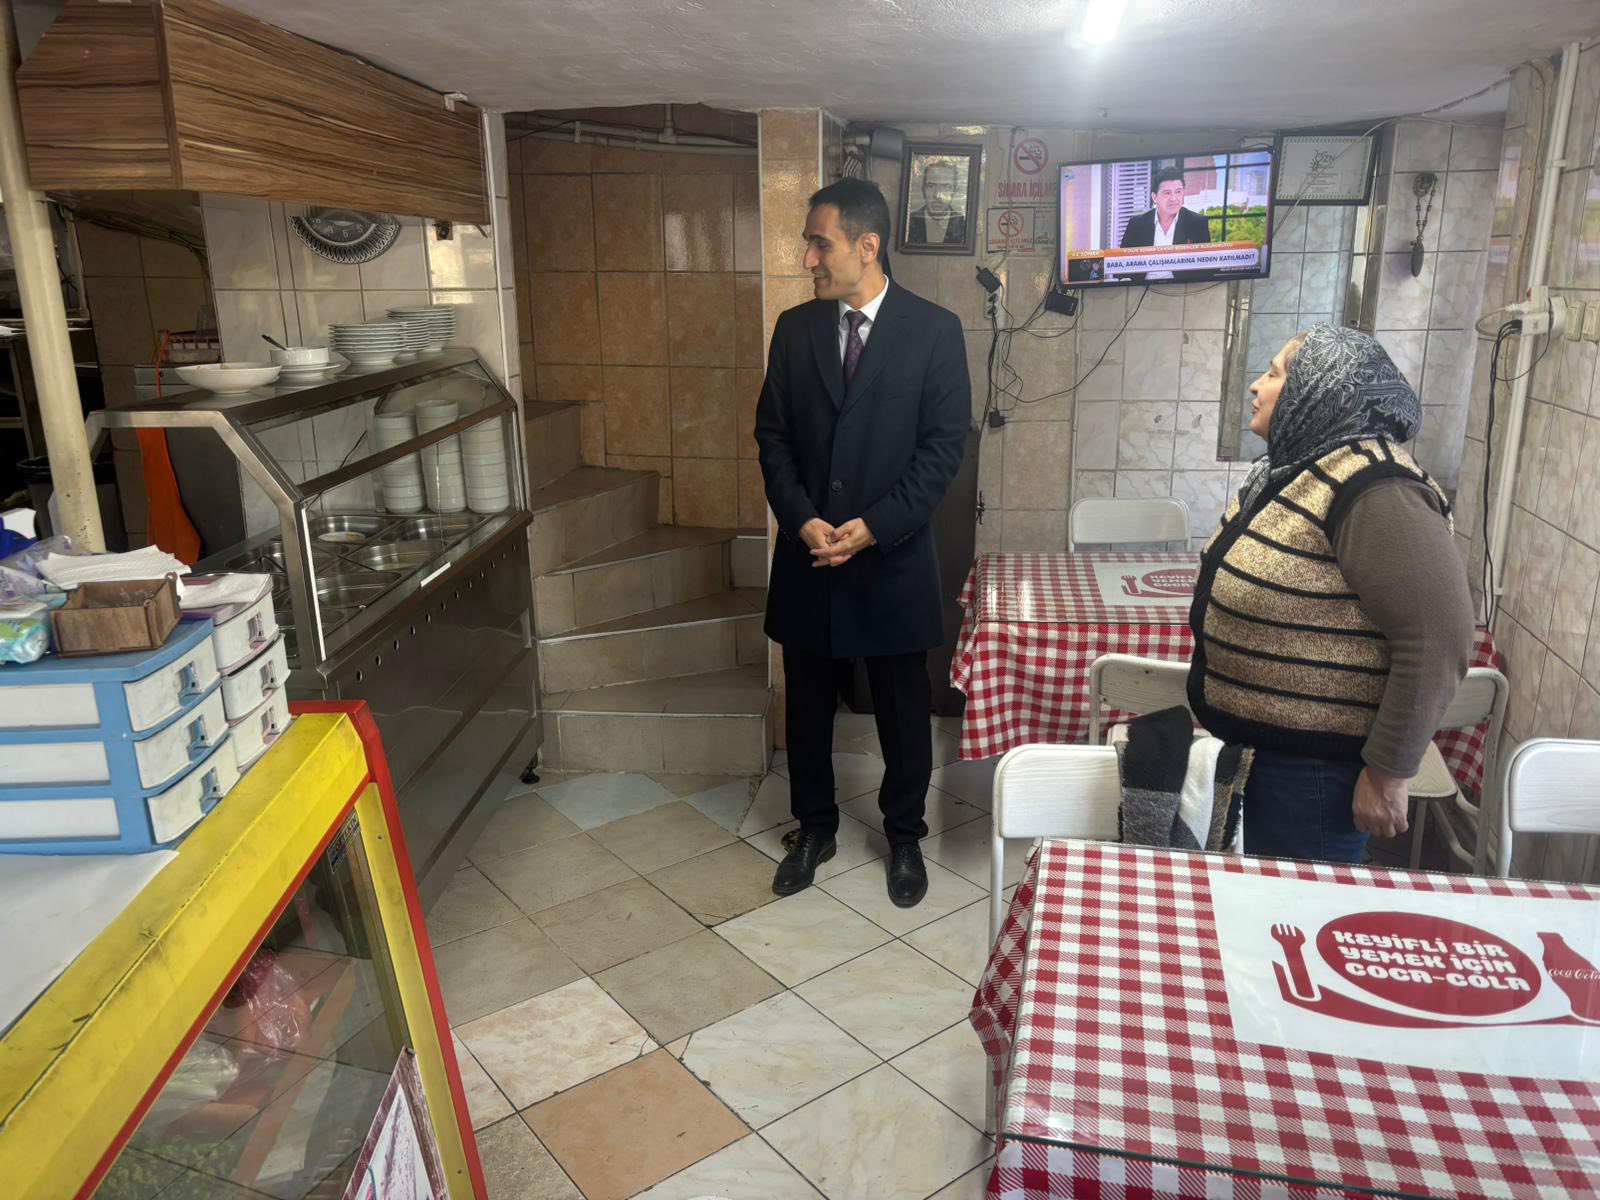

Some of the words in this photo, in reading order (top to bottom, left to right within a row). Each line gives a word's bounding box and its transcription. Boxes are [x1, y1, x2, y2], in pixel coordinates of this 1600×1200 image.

[1106, 261, 1124, 270] BABA,
[1125, 260, 1147, 268] ARAMA
[1148, 257, 1195, 267] ÇALIŞMALARINA
[1197, 255, 1218, 264] NEDEN
[1219, 253, 1255, 263] KATILMADI?
[1332, 930, 1448, 953] KEYİFLİ
[1452, 940, 1509, 957] BİR
[1337, 946, 1446, 968] YEMEK
[1449, 954, 1517, 974] İÇİN
[1345, 962, 1531, 991] COCA-COLA
